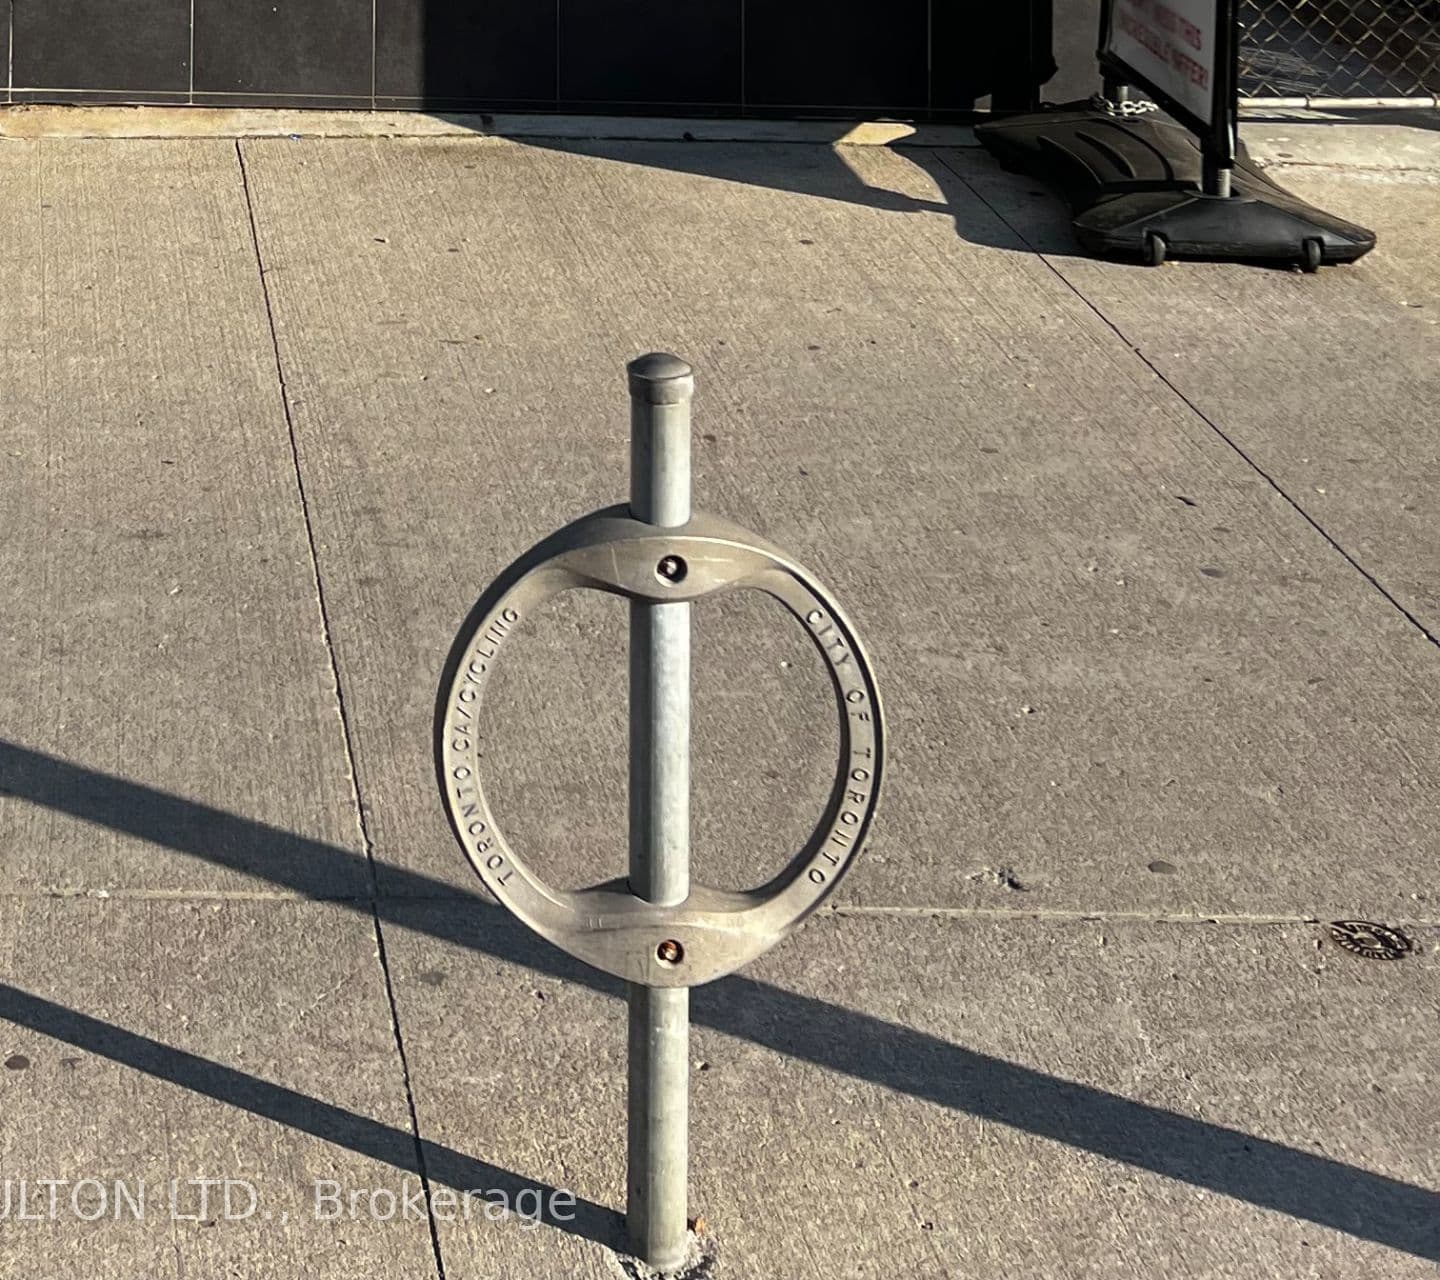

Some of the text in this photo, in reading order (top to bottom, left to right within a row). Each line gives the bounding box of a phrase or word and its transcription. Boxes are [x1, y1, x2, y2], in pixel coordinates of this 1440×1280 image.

[451, 606, 520, 889] TORONTO.CA/CYCLING
[805, 608, 872, 886] CITY OF TORONTO
